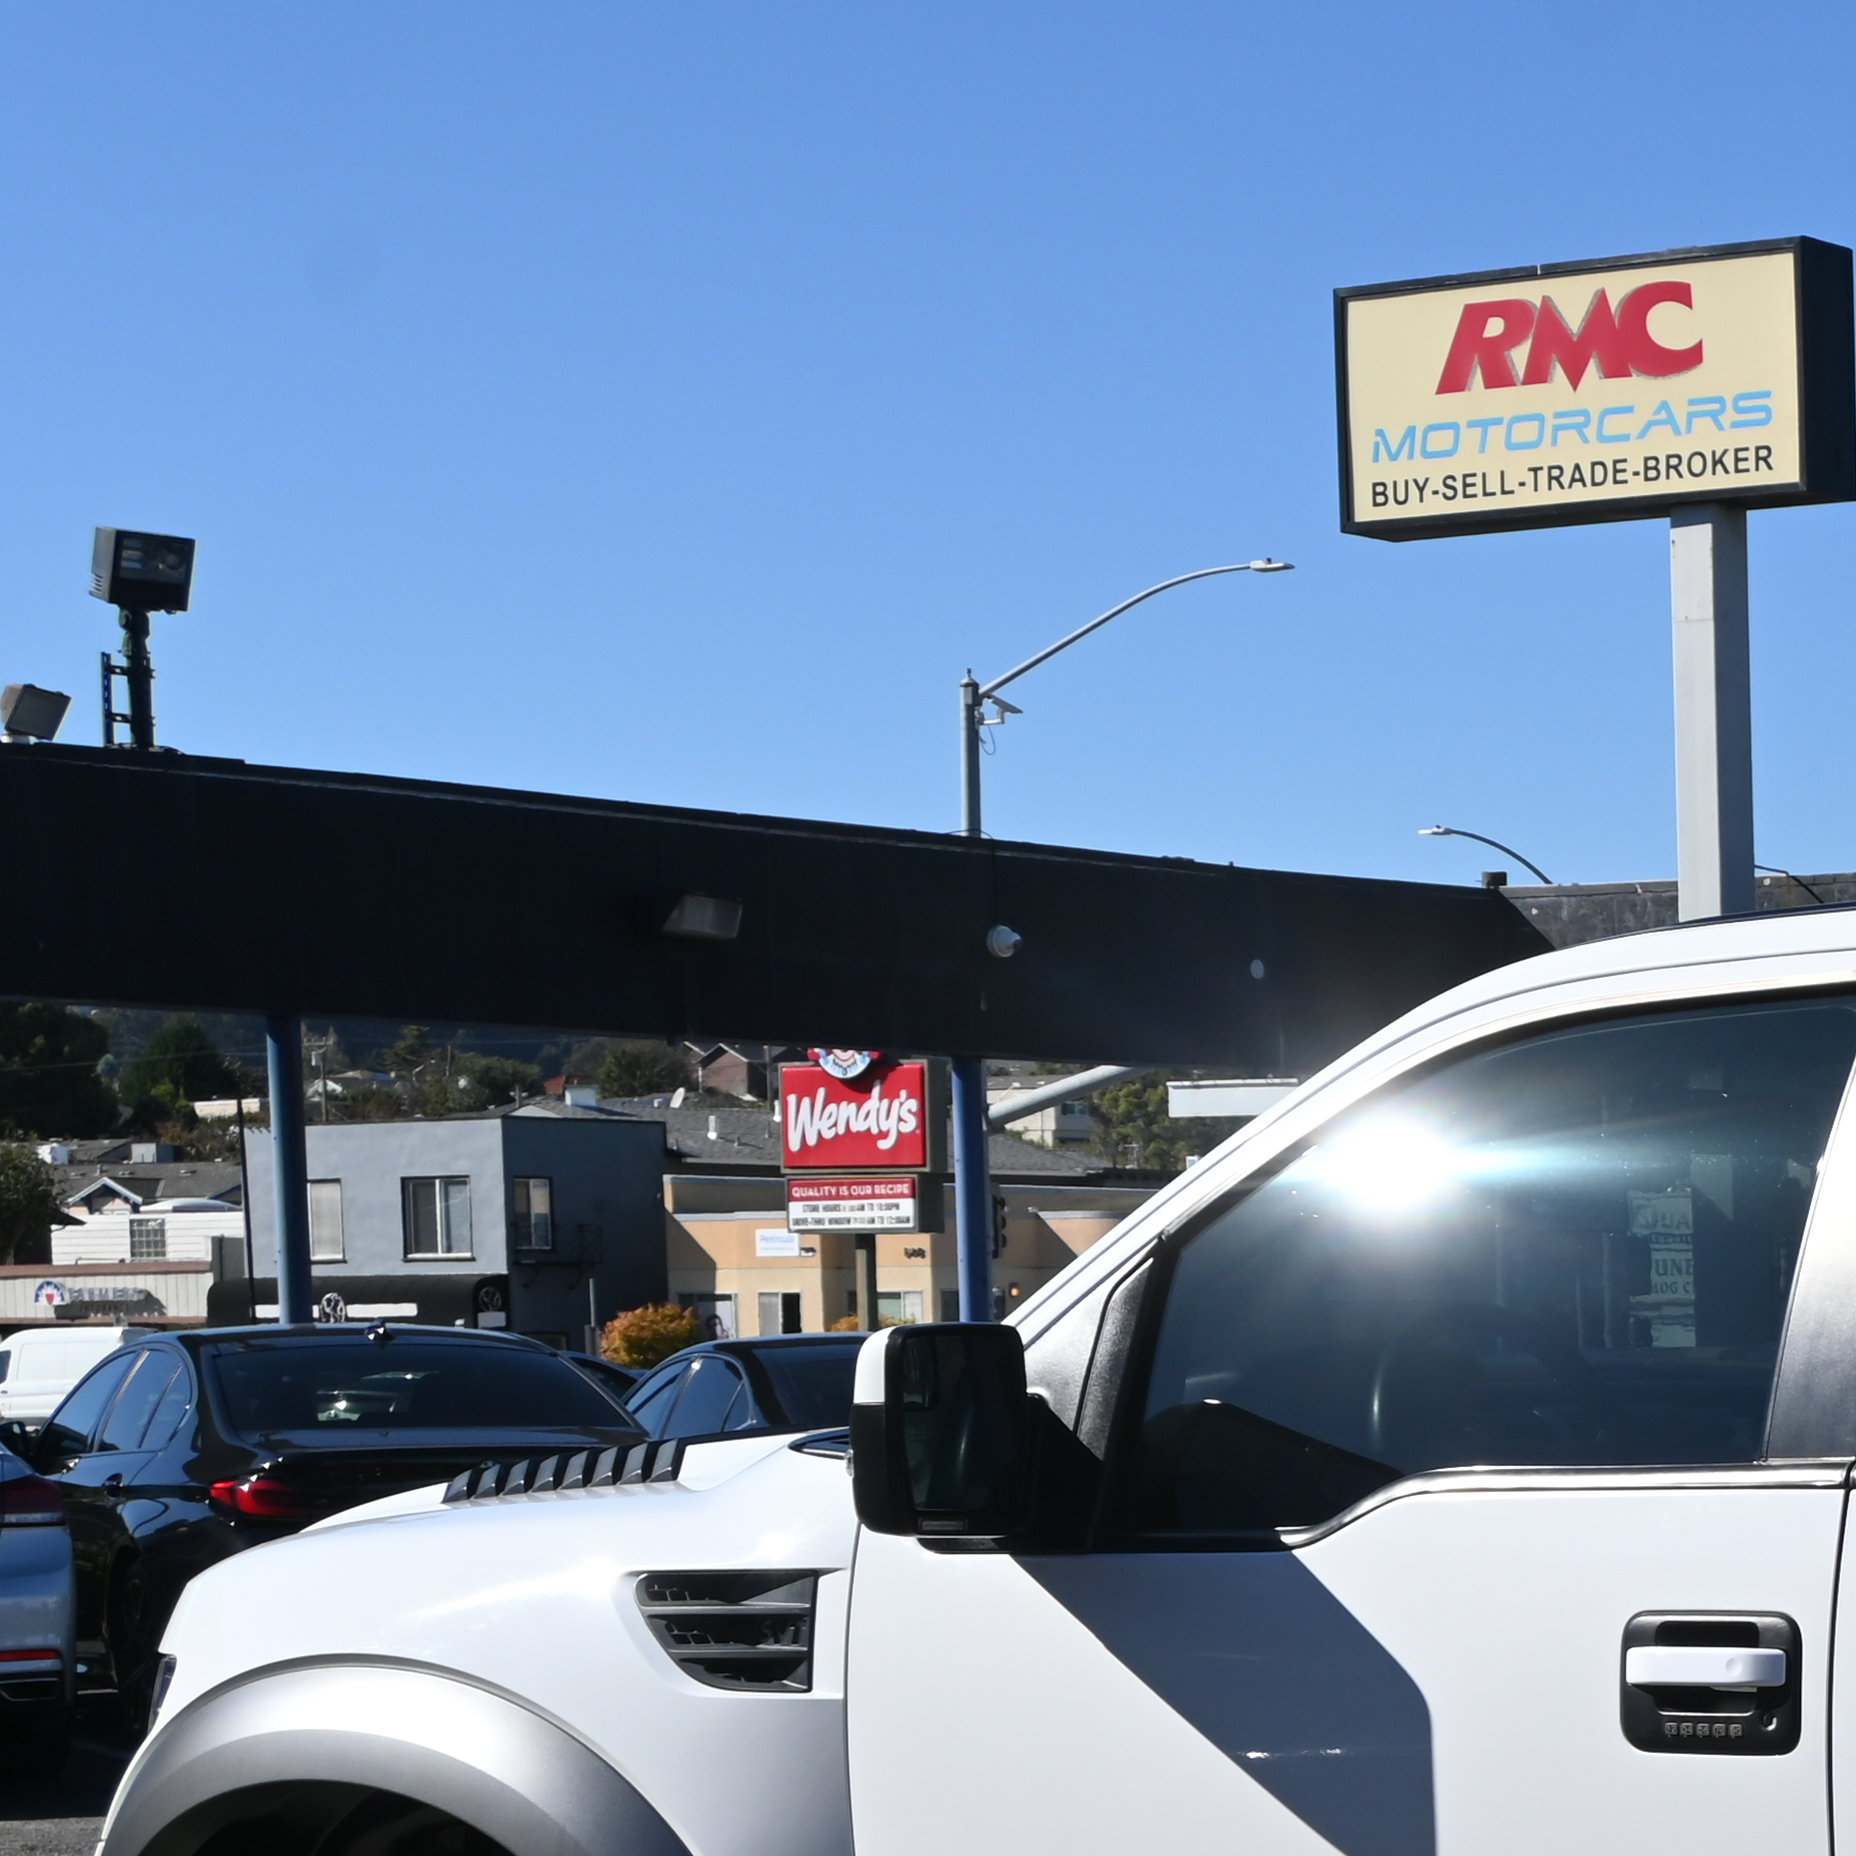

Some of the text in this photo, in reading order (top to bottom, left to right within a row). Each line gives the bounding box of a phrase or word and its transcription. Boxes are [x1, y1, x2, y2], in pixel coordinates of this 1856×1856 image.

[1435, 280, 1703, 394] RMC
[1371, 390, 1773, 463] MOTORCARS
[1371, 444, 1774, 507] BUY-SELL-TRADE-BROKER
[787, 1080, 918, 1152] Wendy's
[791, 1183, 910, 1197] QUALITY IS OUR RECIPE
